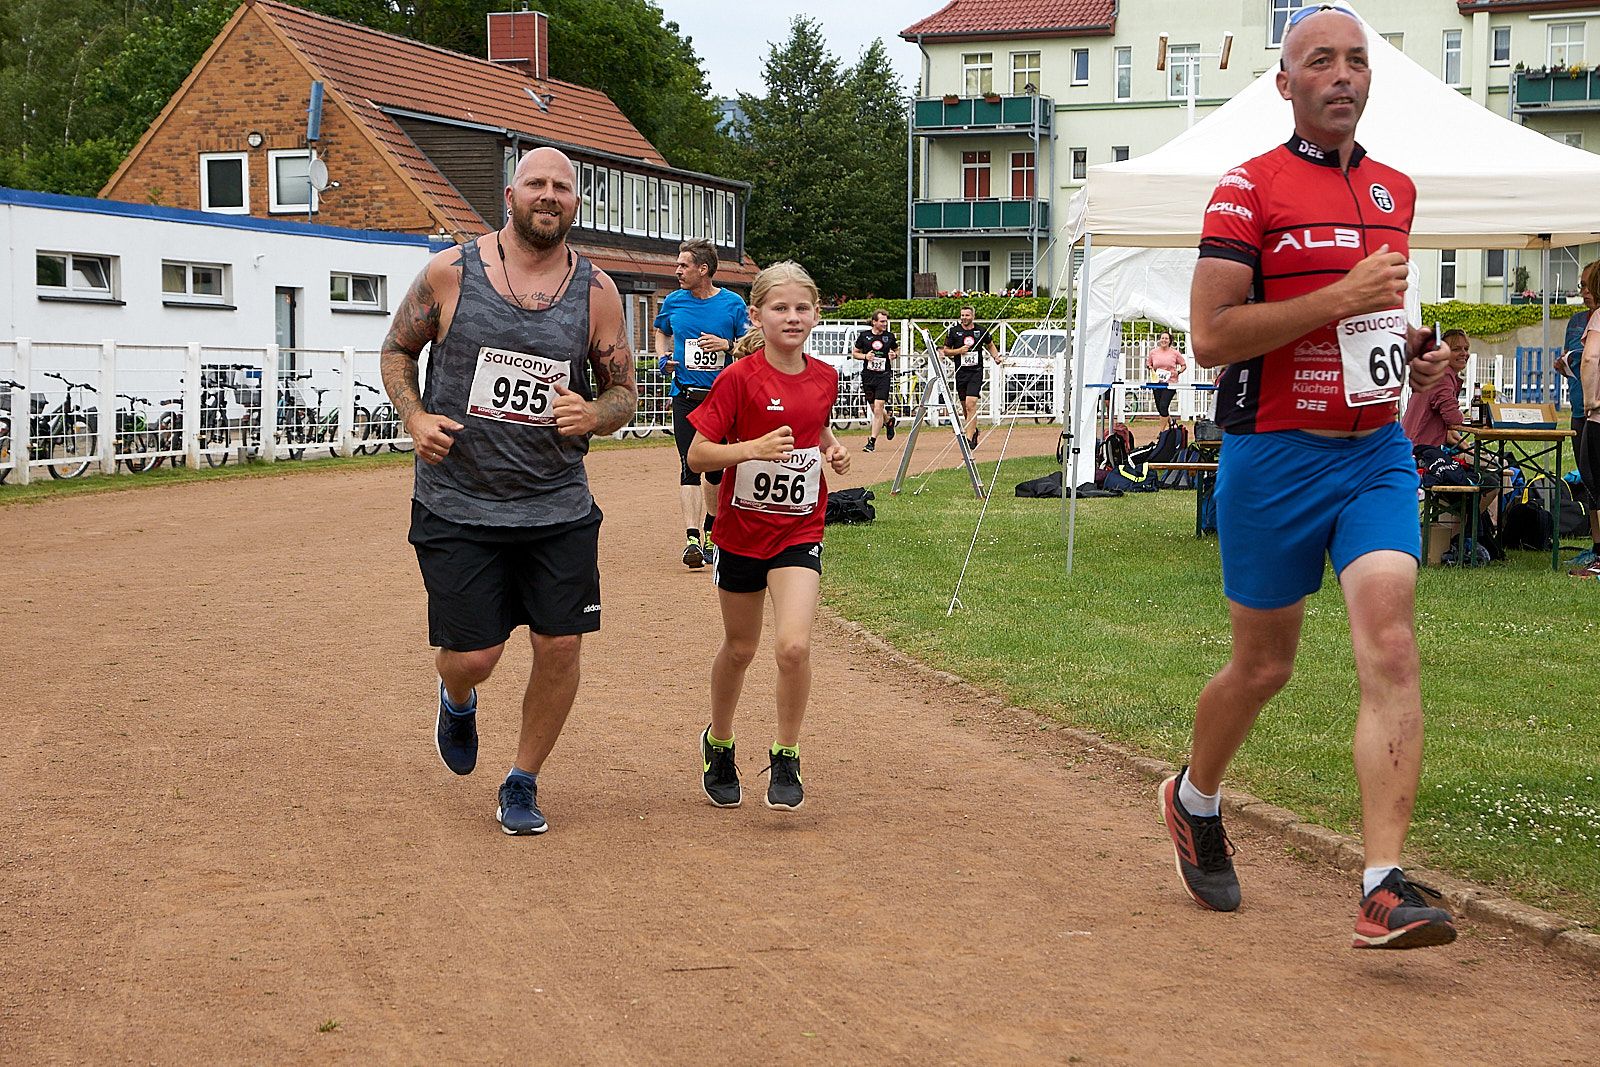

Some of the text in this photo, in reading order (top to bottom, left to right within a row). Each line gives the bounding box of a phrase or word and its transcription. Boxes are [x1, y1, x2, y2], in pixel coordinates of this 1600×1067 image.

[1298, 140, 1325, 159] DEE
[1273, 229, 1361, 254] ALB
[484, 352, 553, 374] saucony
[694, 351, 718, 366] 959
[1295, 370, 1340, 381] LEICHT
[492, 377, 551, 414] 955
[1292, 383, 1339, 394] Küchen
[1296, 399, 1328, 411] DEE
[753, 473, 806, 505] 956
